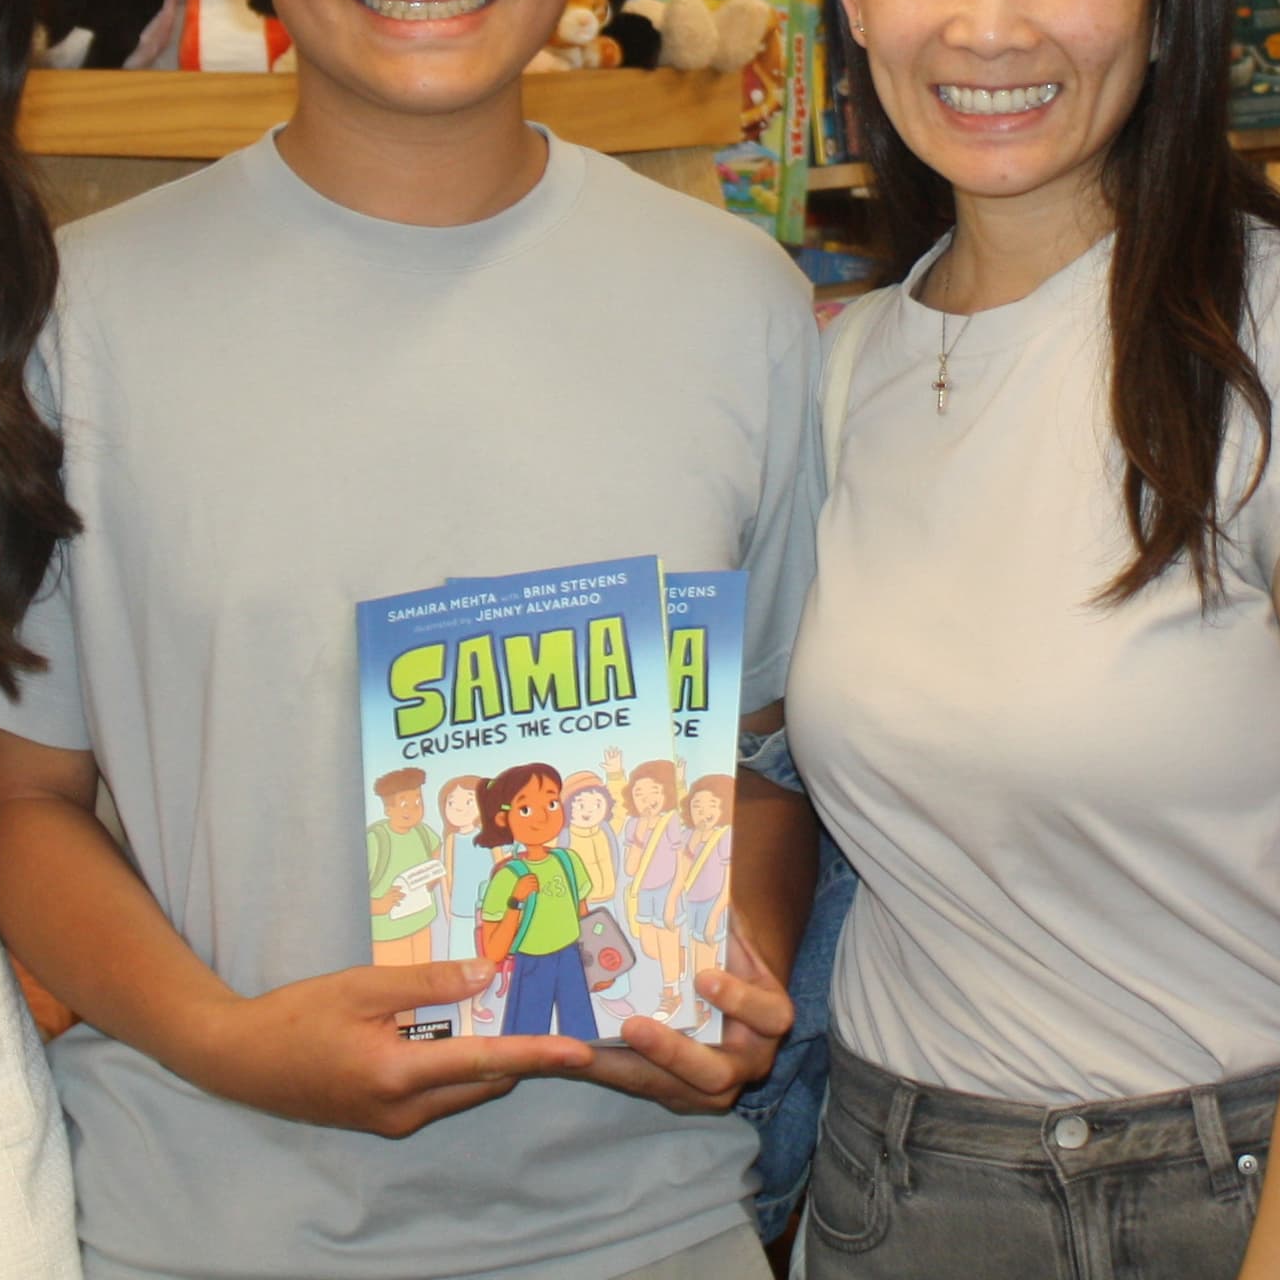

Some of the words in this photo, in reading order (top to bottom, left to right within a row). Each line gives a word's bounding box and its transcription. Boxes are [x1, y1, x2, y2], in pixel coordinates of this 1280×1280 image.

[386, 601, 447, 623] SAMAIRA
[449, 593, 497, 610] MEHTA
[523, 583, 557, 599] BRIN
[560, 572, 628, 593] STEVENS
[475, 604, 522, 623] JENNY
[525, 592, 602, 615] ALVARADO
[665, 584, 717, 599] EVENS
[387, 613, 637, 740] SAMA
[401, 722, 508, 761] CRUSHES
[517, 719, 552, 740] THE
[558, 707, 632, 735] CODE
